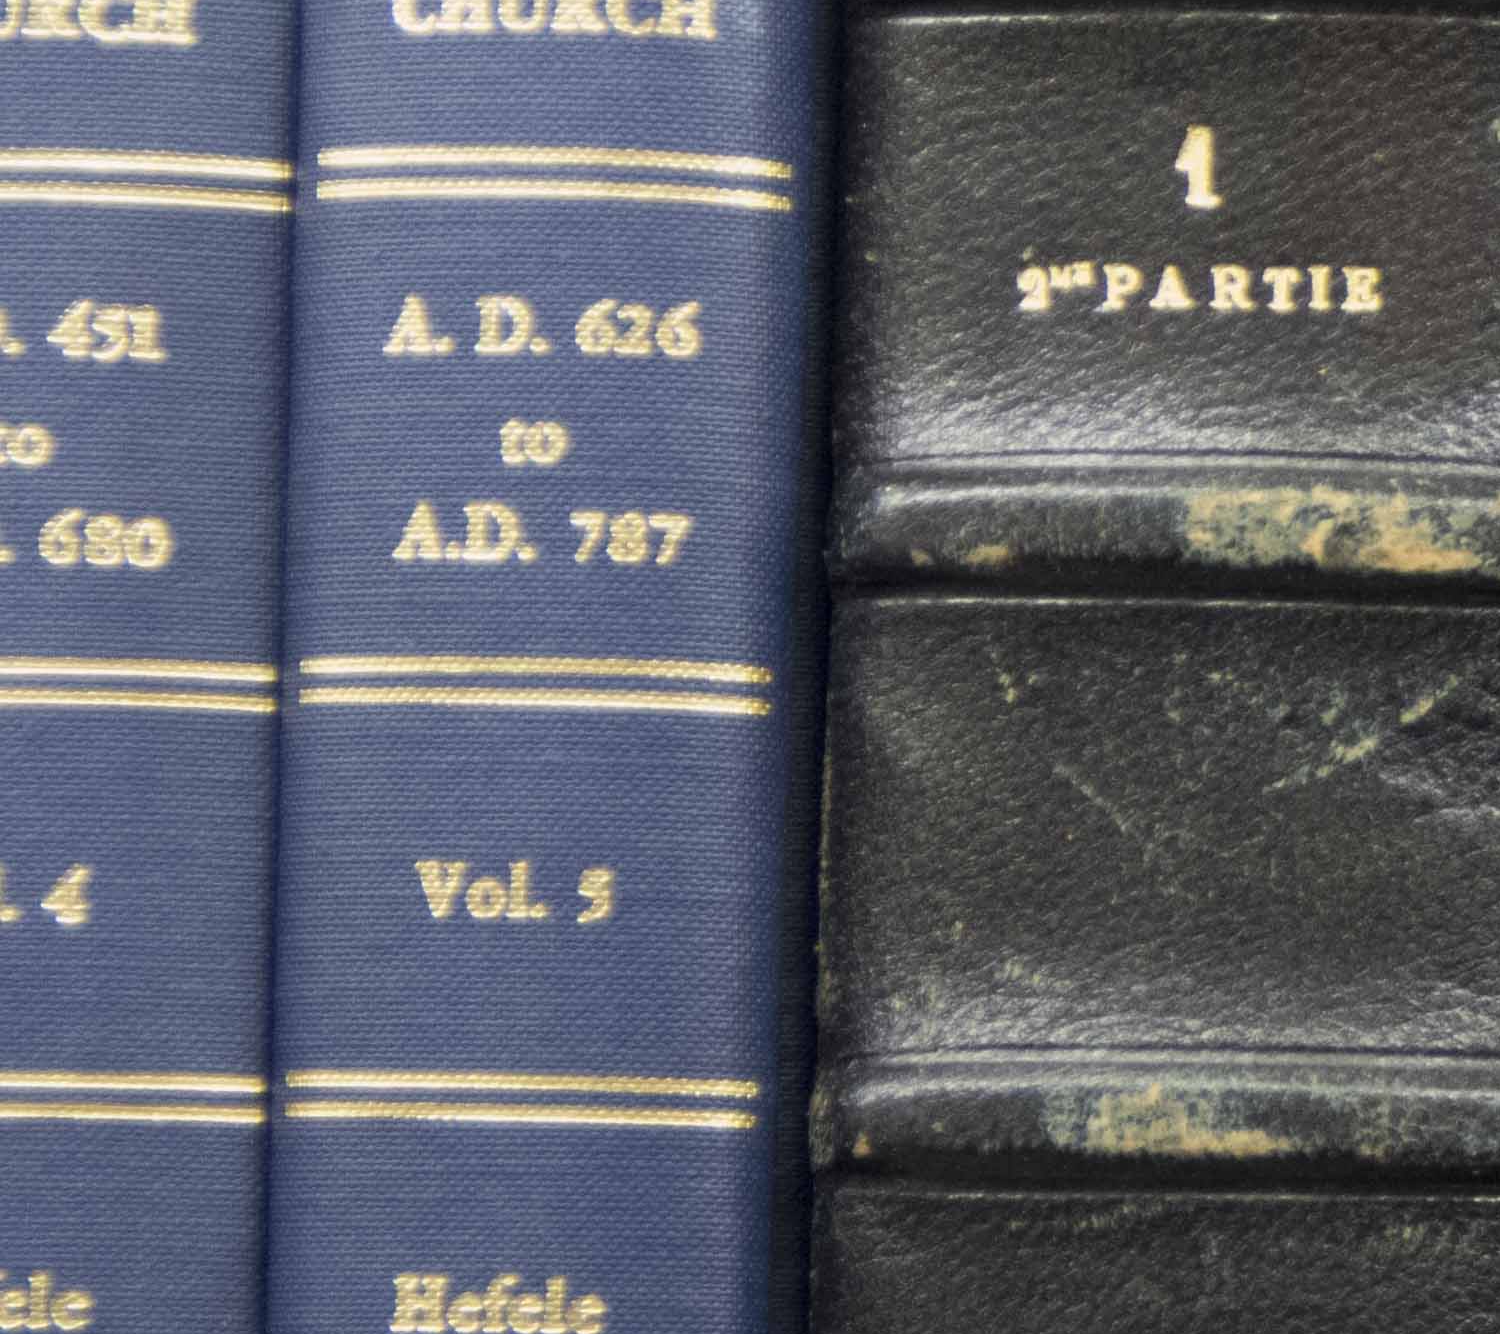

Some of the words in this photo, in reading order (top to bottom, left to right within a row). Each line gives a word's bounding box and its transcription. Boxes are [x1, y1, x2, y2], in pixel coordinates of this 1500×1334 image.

[1174, 124, 1225, 209] 1
[46, 299, 169, 363] 451
[573, 298, 704, 361] 626
[497, 417, 572, 467] to
[37, 507, 174, 571] 680
[568, 509, 694, 566] 787
[39, 861, 94, 928] 4
[414, 860, 550, 922] Vol.
[575, 865, 617, 925] 5
